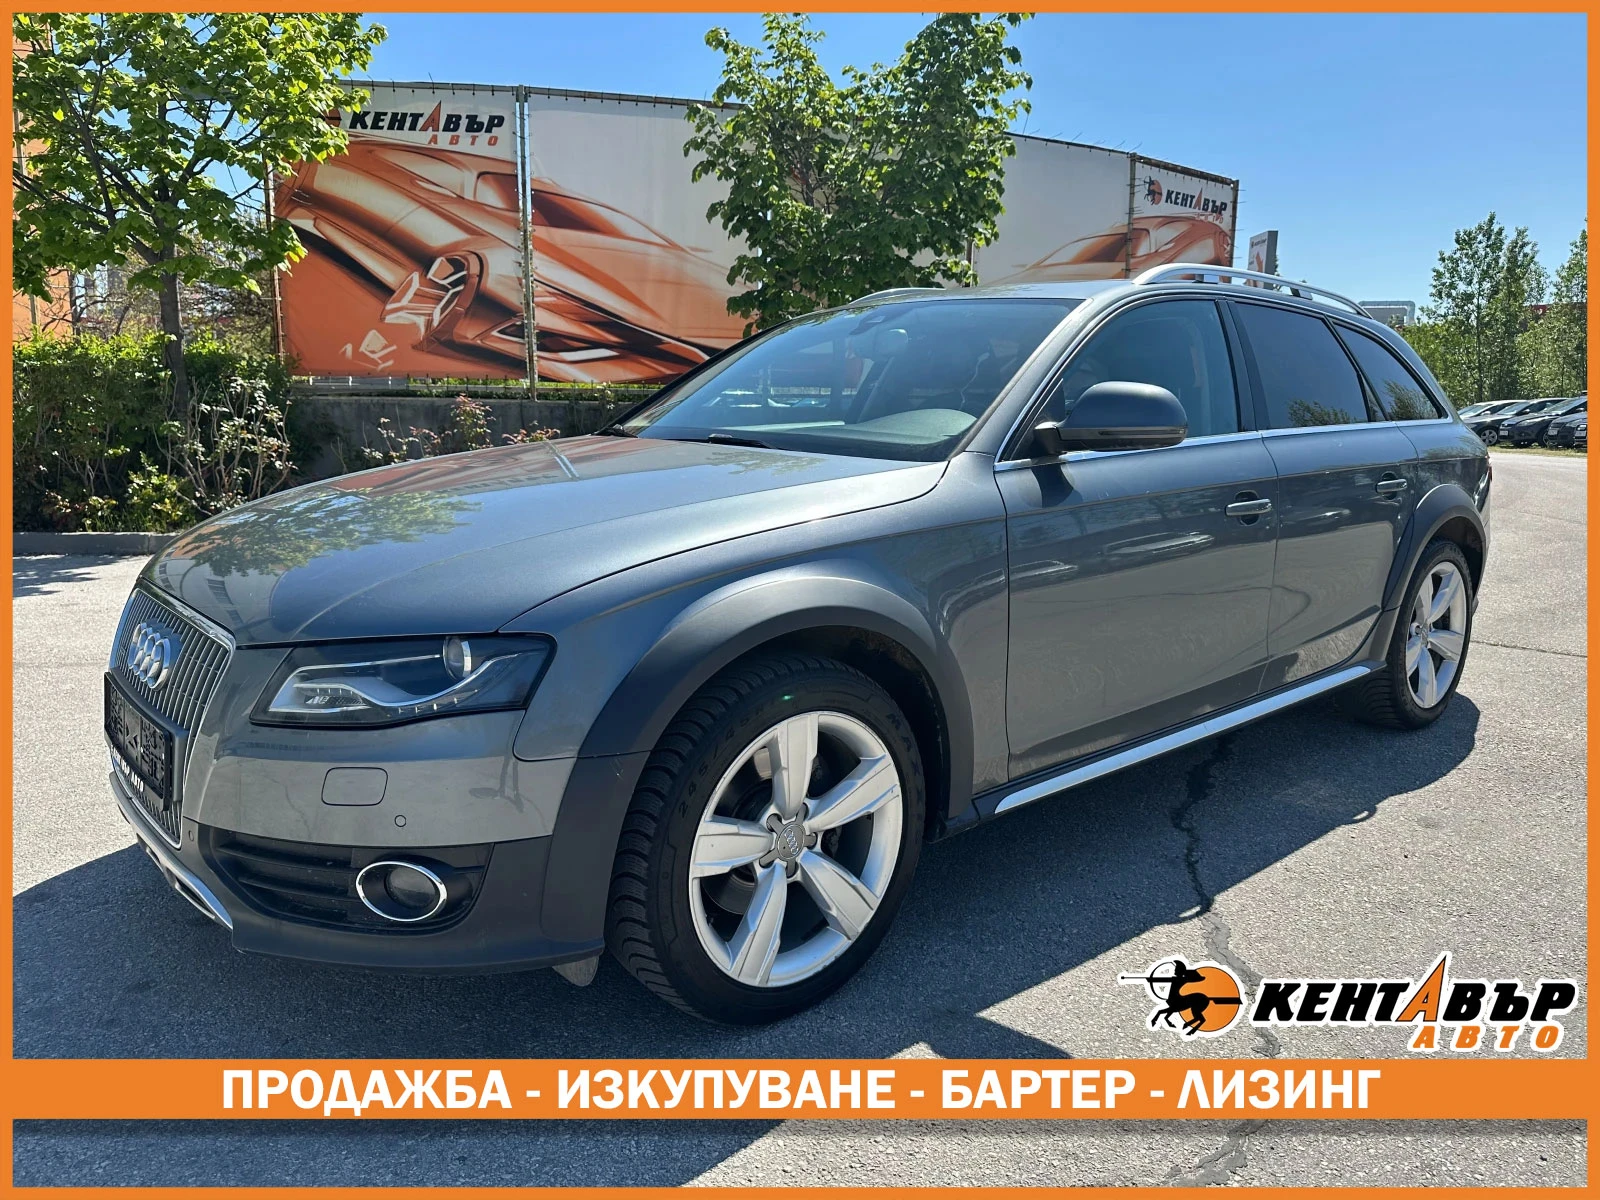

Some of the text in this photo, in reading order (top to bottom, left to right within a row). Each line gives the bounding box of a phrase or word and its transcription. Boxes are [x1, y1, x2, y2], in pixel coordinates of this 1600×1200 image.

[349, 100, 505, 133] КЕНТАВЪР
[428, 134, 499, 146] АВТО
[1165, 187, 1228, 215] КЕНТАВЪР
